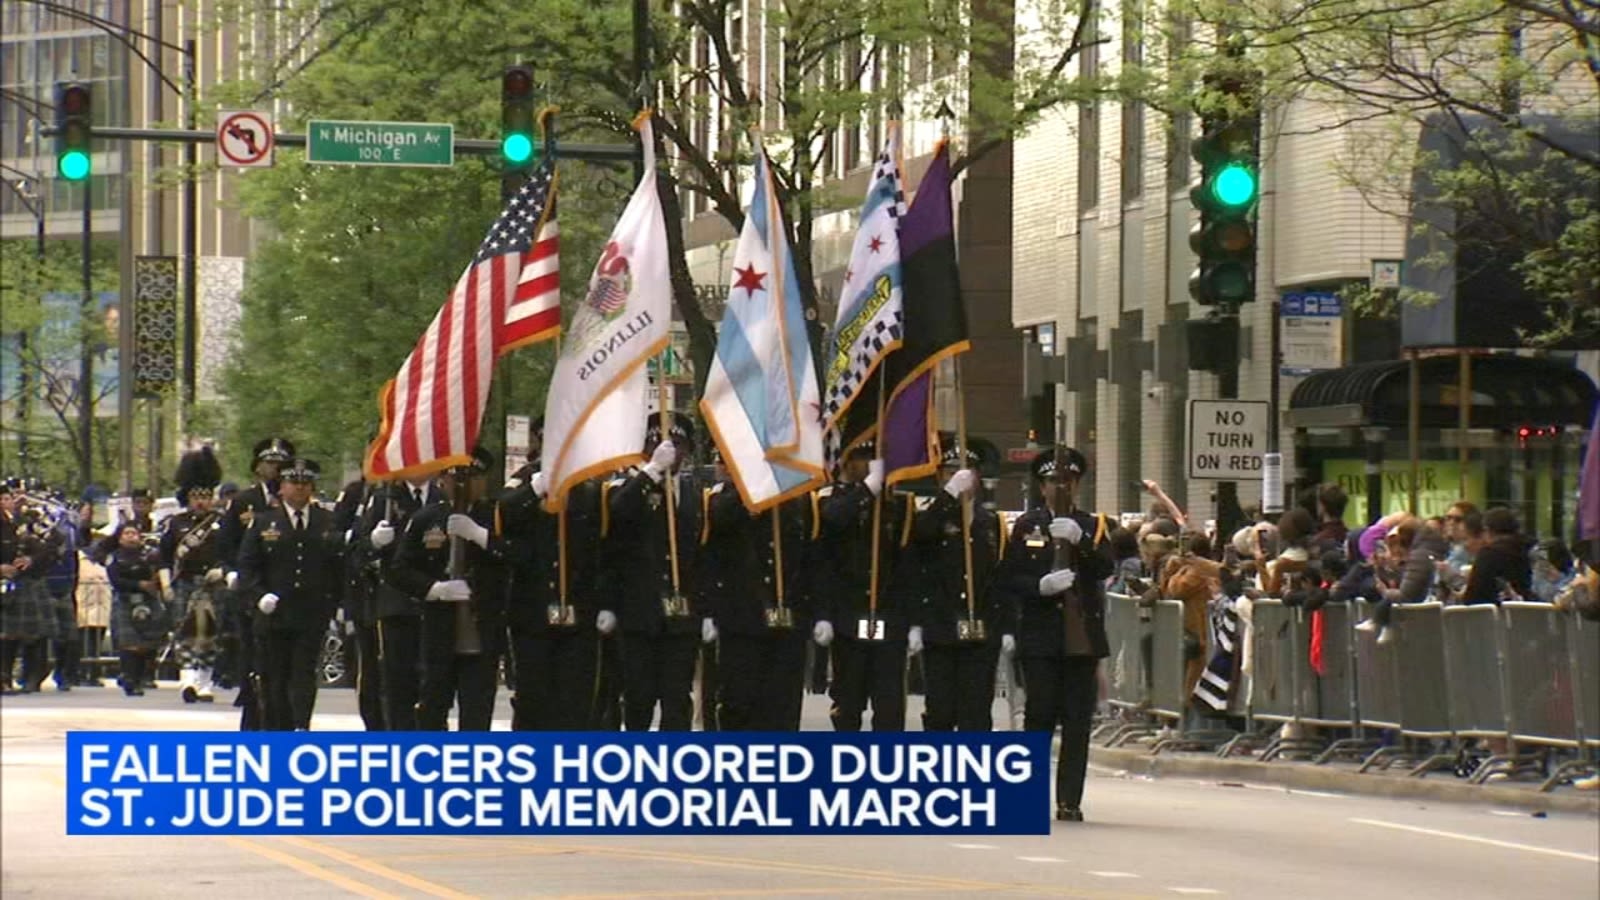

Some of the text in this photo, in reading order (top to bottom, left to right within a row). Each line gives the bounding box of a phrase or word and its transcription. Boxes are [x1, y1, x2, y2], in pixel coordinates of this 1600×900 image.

[320, 127, 440, 149] N Michigan Av
[359, 147, 401, 160] 100 E
[137, 367, 174, 380] AGO
[1215, 410, 1245, 425] NO
[1207, 432, 1254, 448] TURN
[1196, 454, 1263, 471] ON RED
[1338, 474, 1369, 495] FIN
